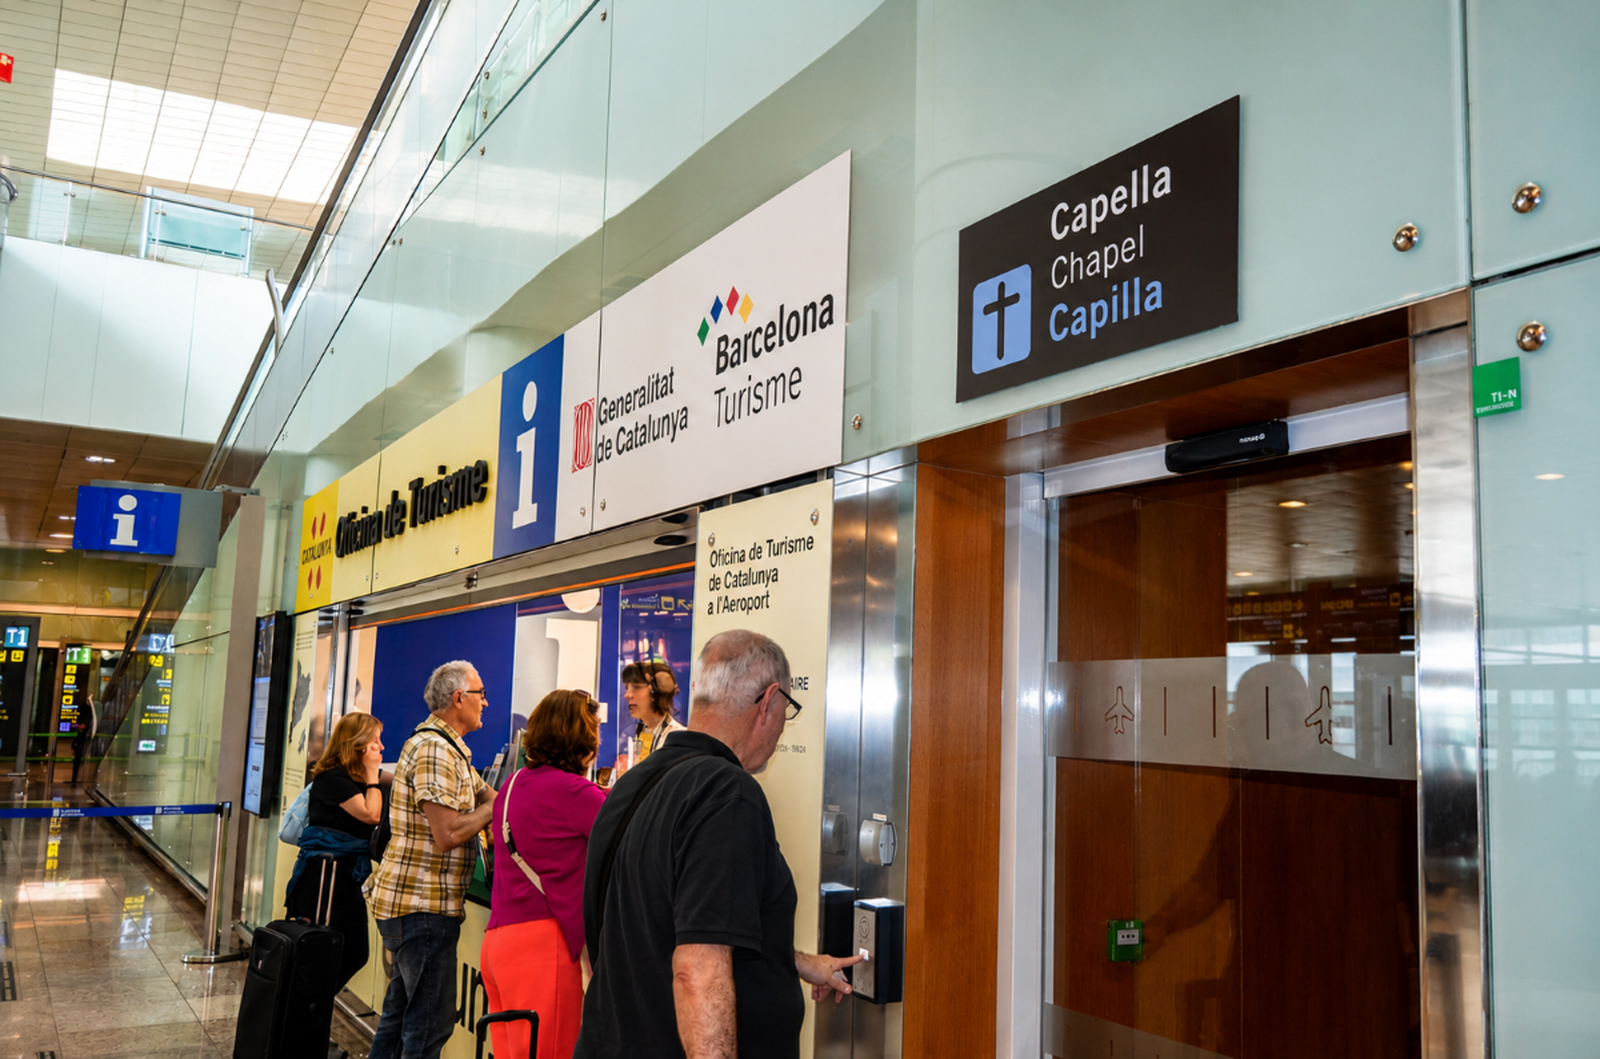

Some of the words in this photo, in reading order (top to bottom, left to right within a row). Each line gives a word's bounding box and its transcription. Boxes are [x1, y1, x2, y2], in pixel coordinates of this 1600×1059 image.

[1051, 164, 1171, 240] Capella
[1052, 224, 1144, 289] Chapel
[716, 293, 834, 375] Barcelona
[1050, 277, 1163, 341] Capilla
[598, 366, 674, 426] Generalitat
[714, 366, 802, 428] Turisme
[597, 434, 612, 464] de
[615, 406, 689, 456] Catalunya
[335, 505, 383, 558] Oficina
[384, 490, 407, 539] de
[408, 459, 489, 528] Turisme
[302, 537, 332, 565] CATALUNYA
[708, 574, 721, 591] de
[724, 567, 779, 588] Catalunya
[709, 546, 746, 568] Oficina
[748, 542, 763, 561] de
[766, 535, 814, 558] Turisme
[707, 601, 714, 615] a
[716, 590, 770, 615] l'Aeroport
